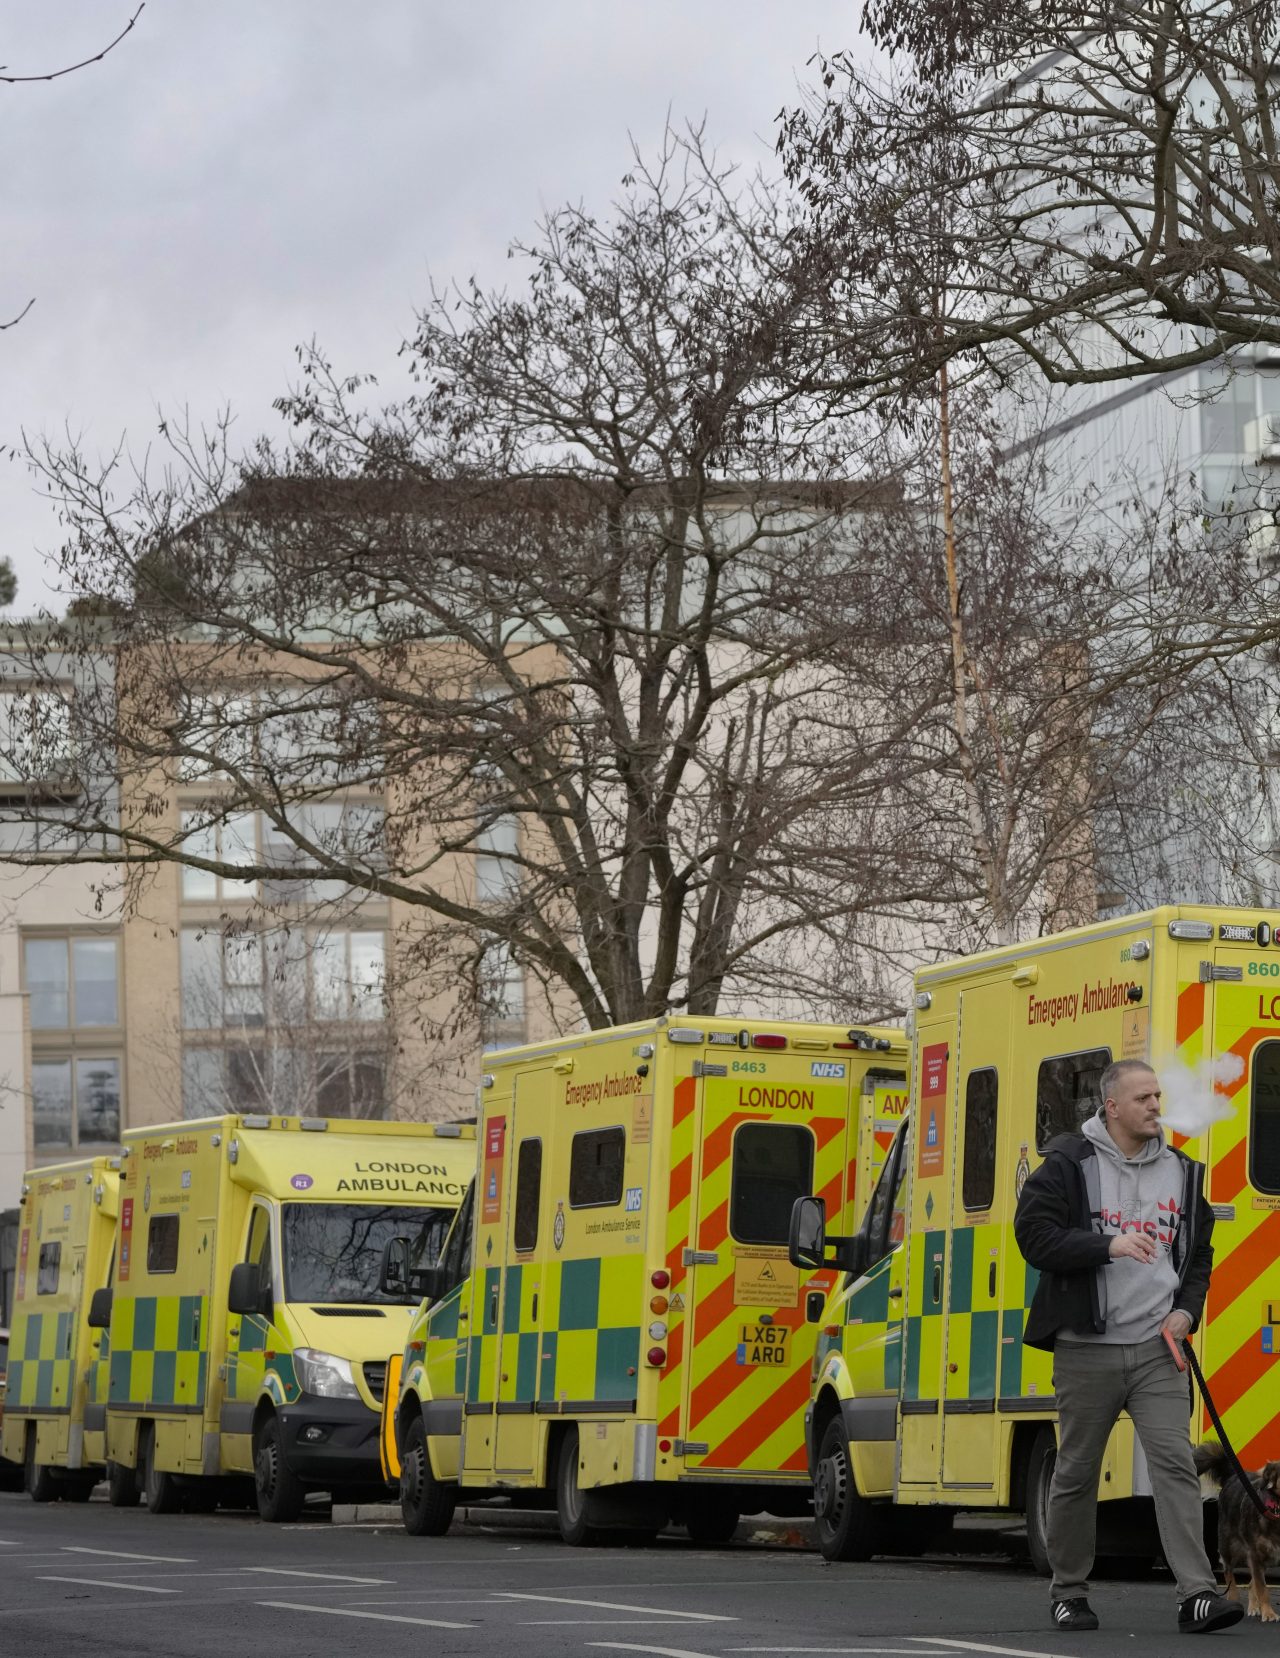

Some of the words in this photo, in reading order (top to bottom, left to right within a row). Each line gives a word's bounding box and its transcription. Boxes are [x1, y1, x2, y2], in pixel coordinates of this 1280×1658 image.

[1120, 948, 1132, 963] 860
[1028, 993, 1079, 1027] Emergency
[731, 1061, 767, 1074] 8463
[811, 1063, 844, 1078] NHS
[565, 1080, 603, 1108] Emergency
[603, 1070, 642, 1098] Ambulance
[738, 1086, 814, 1110] LONDON
[882, 1095, 908, 1115] AM
[355, 1162, 448, 1177] LONDON
[295, 1180, 308, 1188] R1
[625, 1189, 642, 1211] NHS
[1101, 1208, 1158, 1241] idas
[742, 1325, 788, 1344] LX67
[751, 1346, 785, 1364] ARO
